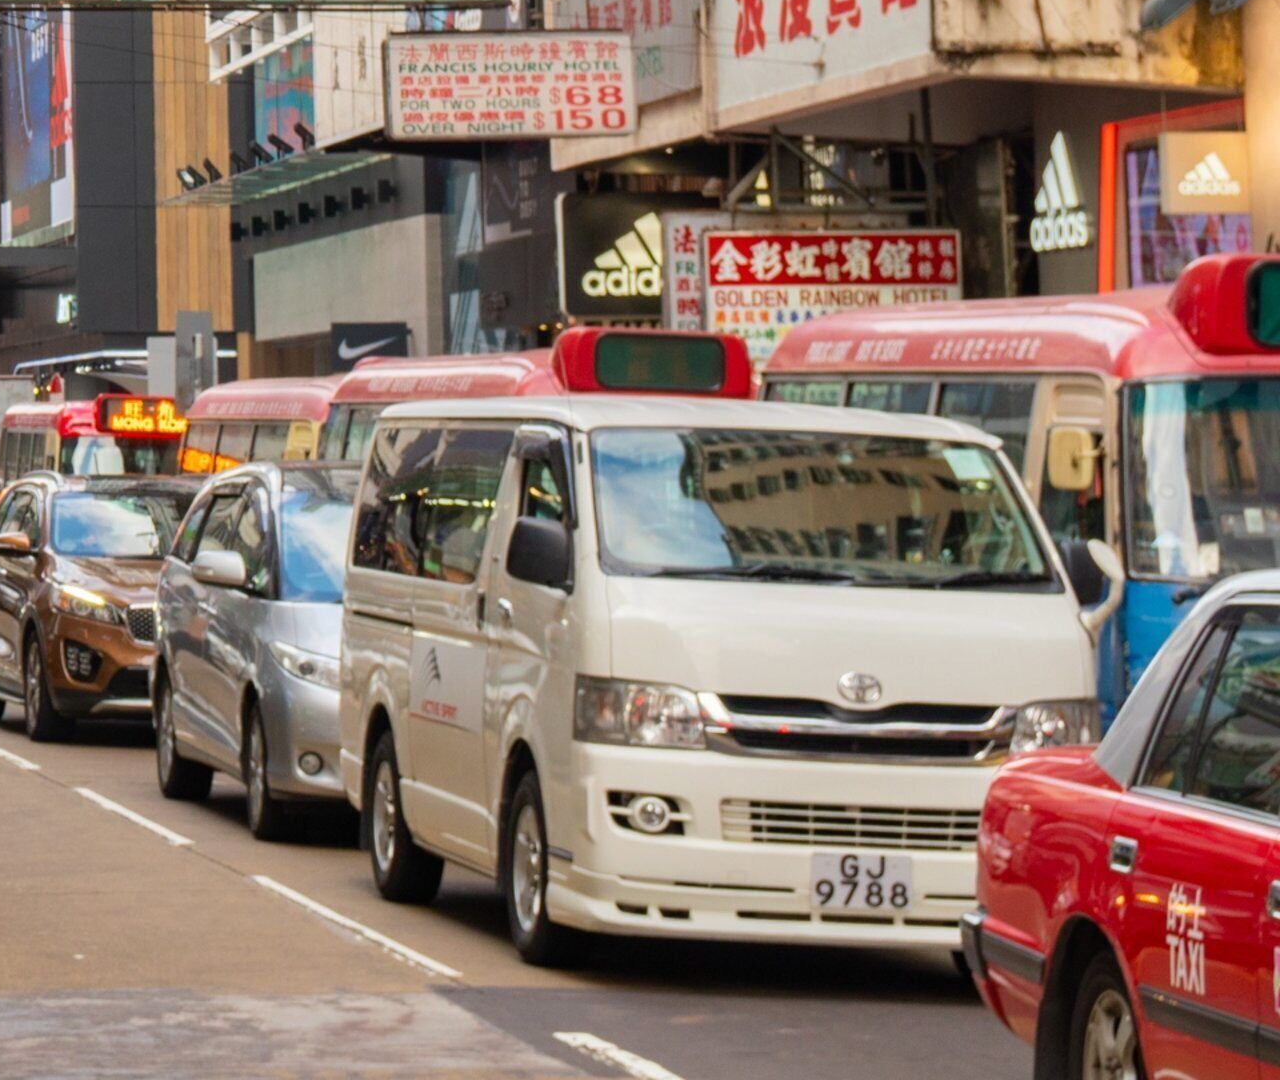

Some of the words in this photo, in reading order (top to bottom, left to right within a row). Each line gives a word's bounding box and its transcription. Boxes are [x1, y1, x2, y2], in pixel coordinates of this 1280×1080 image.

[398, 61, 477, 74] FRANCIS
[485, 61, 554, 73] HOURLY
[564, 60, 621, 71] HOTEL
[400, 99, 429, 110] FOR
[442, 98, 476, 110] TWO
[486, 98, 541, 110] HOURS
[549, 85, 624, 106] $68
[402, 122, 454, 134] OVER
[468, 121, 525, 133] NIGHT
[532, 109, 627, 131] $150
[1178, 178, 1240, 196] adidas
[1030, 207, 1088, 253] adidas
[581, 268, 662, 297] adid
[714, 289, 789, 307] GOLDEN
[799, 289, 881, 306] RAINBOW
[814, 880, 911, 910] 9788
[1166, 882, 1207, 941] 的士
[1165, 934, 1206, 996] TAXI
